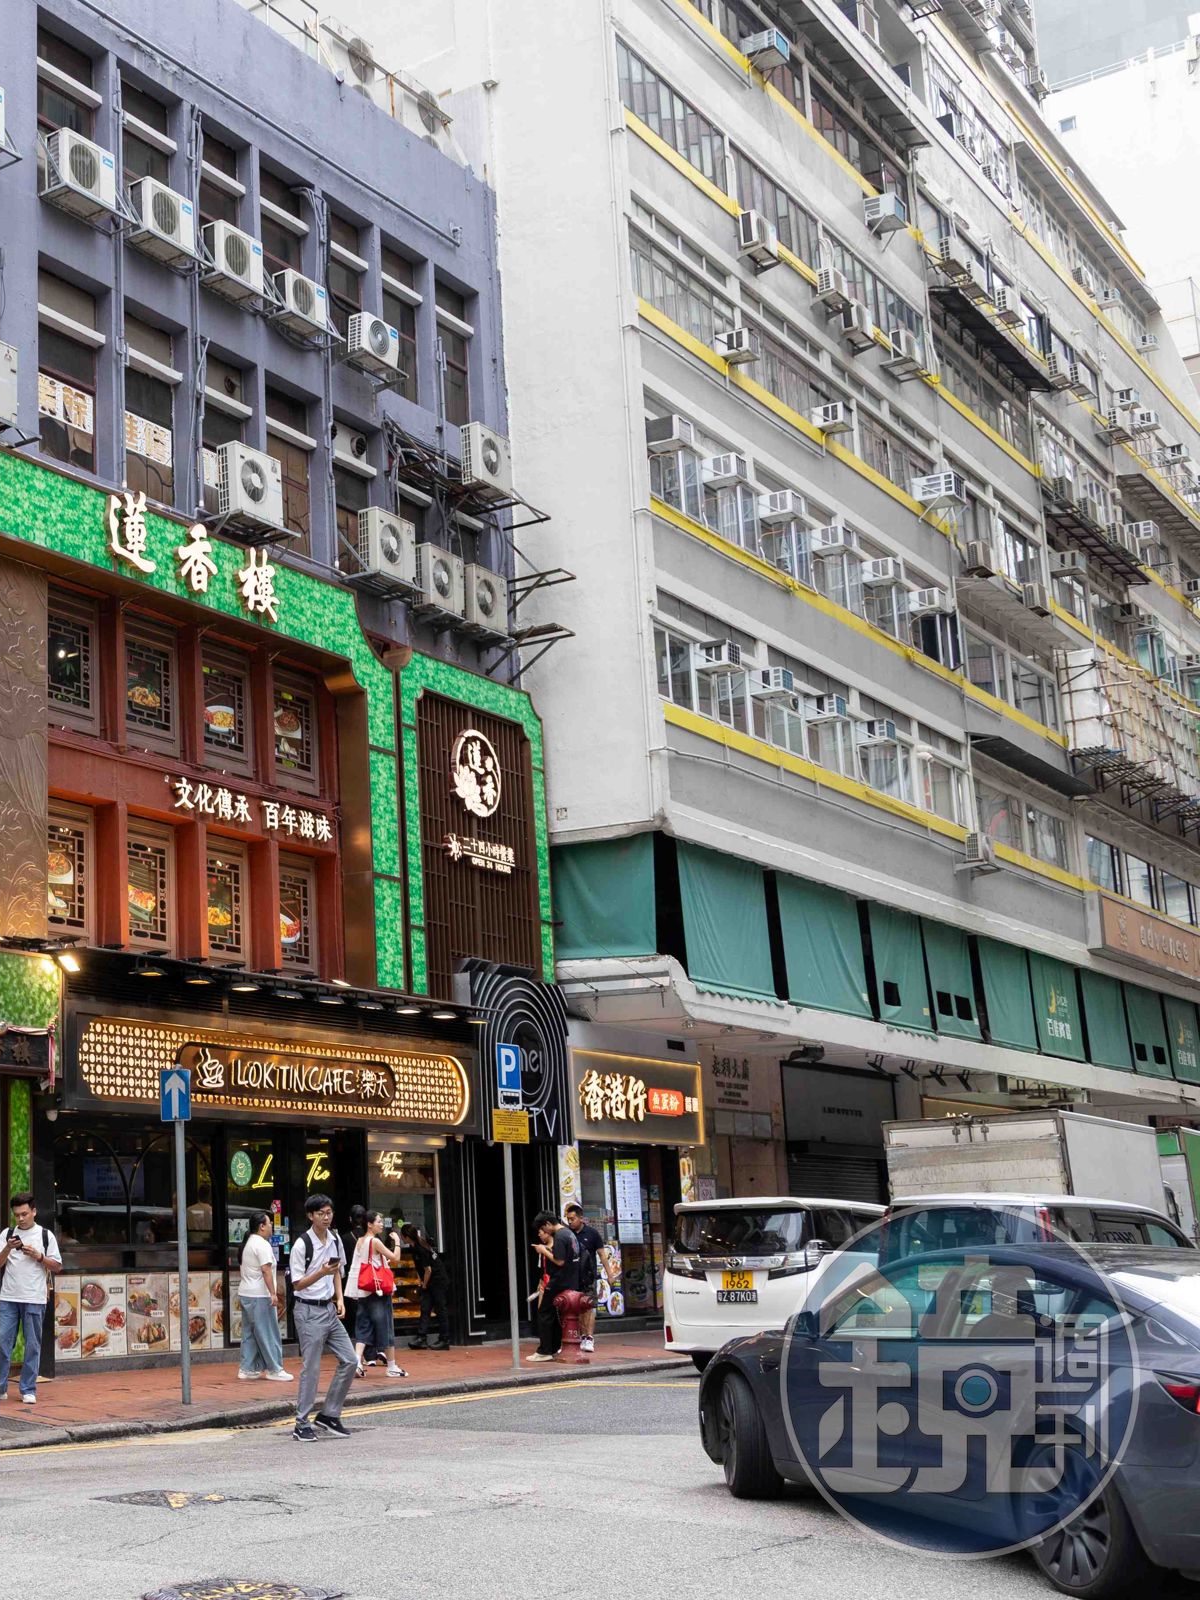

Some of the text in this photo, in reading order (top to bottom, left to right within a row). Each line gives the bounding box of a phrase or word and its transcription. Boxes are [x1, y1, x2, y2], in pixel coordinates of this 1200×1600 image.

[107, 491, 281, 624] 蓮香樓
[173, 776, 334, 843] 文化傳承 百年滋味
[471, 857, 511, 874] OPEN 24 HOURS
[501, 1048, 515, 1085] P
[579, 1069, 647, 1122] 香港仔
[653, 1091, 680, 1111] 魚蛋粉
[523, 1107, 557, 1138] TV
[726, 1280, 749, 1288] 1962
